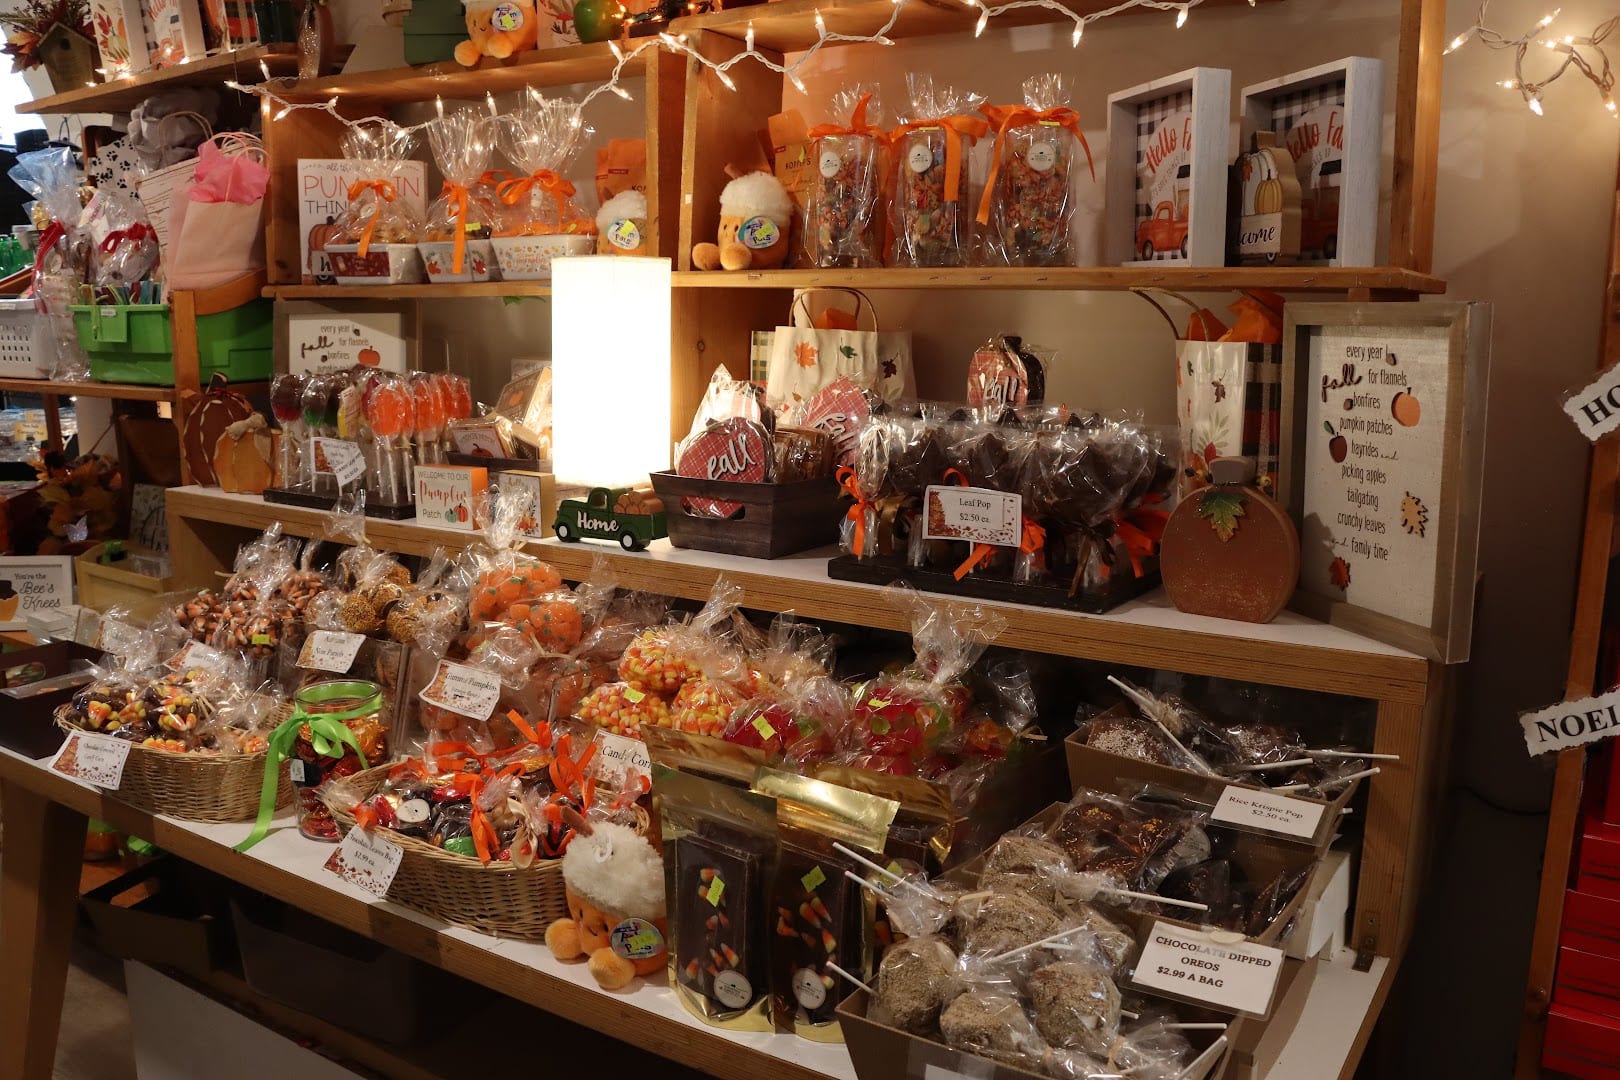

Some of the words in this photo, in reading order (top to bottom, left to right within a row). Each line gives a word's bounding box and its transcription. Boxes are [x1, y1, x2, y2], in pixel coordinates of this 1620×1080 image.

[1146, 127, 1176, 174] Hello
[304, 175, 420, 198] PUMIN
[321, 324, 336, 334] every
[301, 336, 334, 359] fall
[1346, 346, 1366, 361] every
[1367, 346, 1383, 361] year
[1322, 363, 1362, 403] fall
[1368, 369, 1378, 384] for
[1380, 369, 1407, 386] flannels
[1353, 392, 1381, 409] bonfires
[1340, 417, 1365, 434] pumpkin
[1367, 417, 1393, 435] patches
[1351, 439, 1379, 459] hayrides
[417, 471, 446, 480] WELCOME
[1341, 463, 1364, 484] picking
[1366, 467, 1387, 485] apples
[419, 480, 467, 507] Pumpkin
[959, 498, 975, 507] Leaf
[977, 500, 991, 509] Pop
[1347, 487, 1379, 511] tailgating
[422, 509, 441, 519] Patch
[577, 510, 619, 531] Home
[959, 512, 980, 522] $2.50
[1337, 512, 1363, 531] crunchy
[1364, 515, 1386, 534] leaves
[1351, 537, 1372, 559] family
[1373, 543, 1389, 561] time
[19, 581, 54, 594] Bee's
[22, 595, 61, 611] Knees
[1228, 796, 1249, 806] Rice
[1285, 809, 1303, 820] Pop
[1251, 809, 1277, 819] $2.50
[1155, 936, 1226, 959] CHOCOLATE
[1228, 952, 1272, 968] DIPPED
[1180, 956, 1220, 972] OREOS
[1156, 966, 1185, 978] $2.99
[1187, 973, 1196, 982] A
[1199, 975, 1224, 988] BAG
